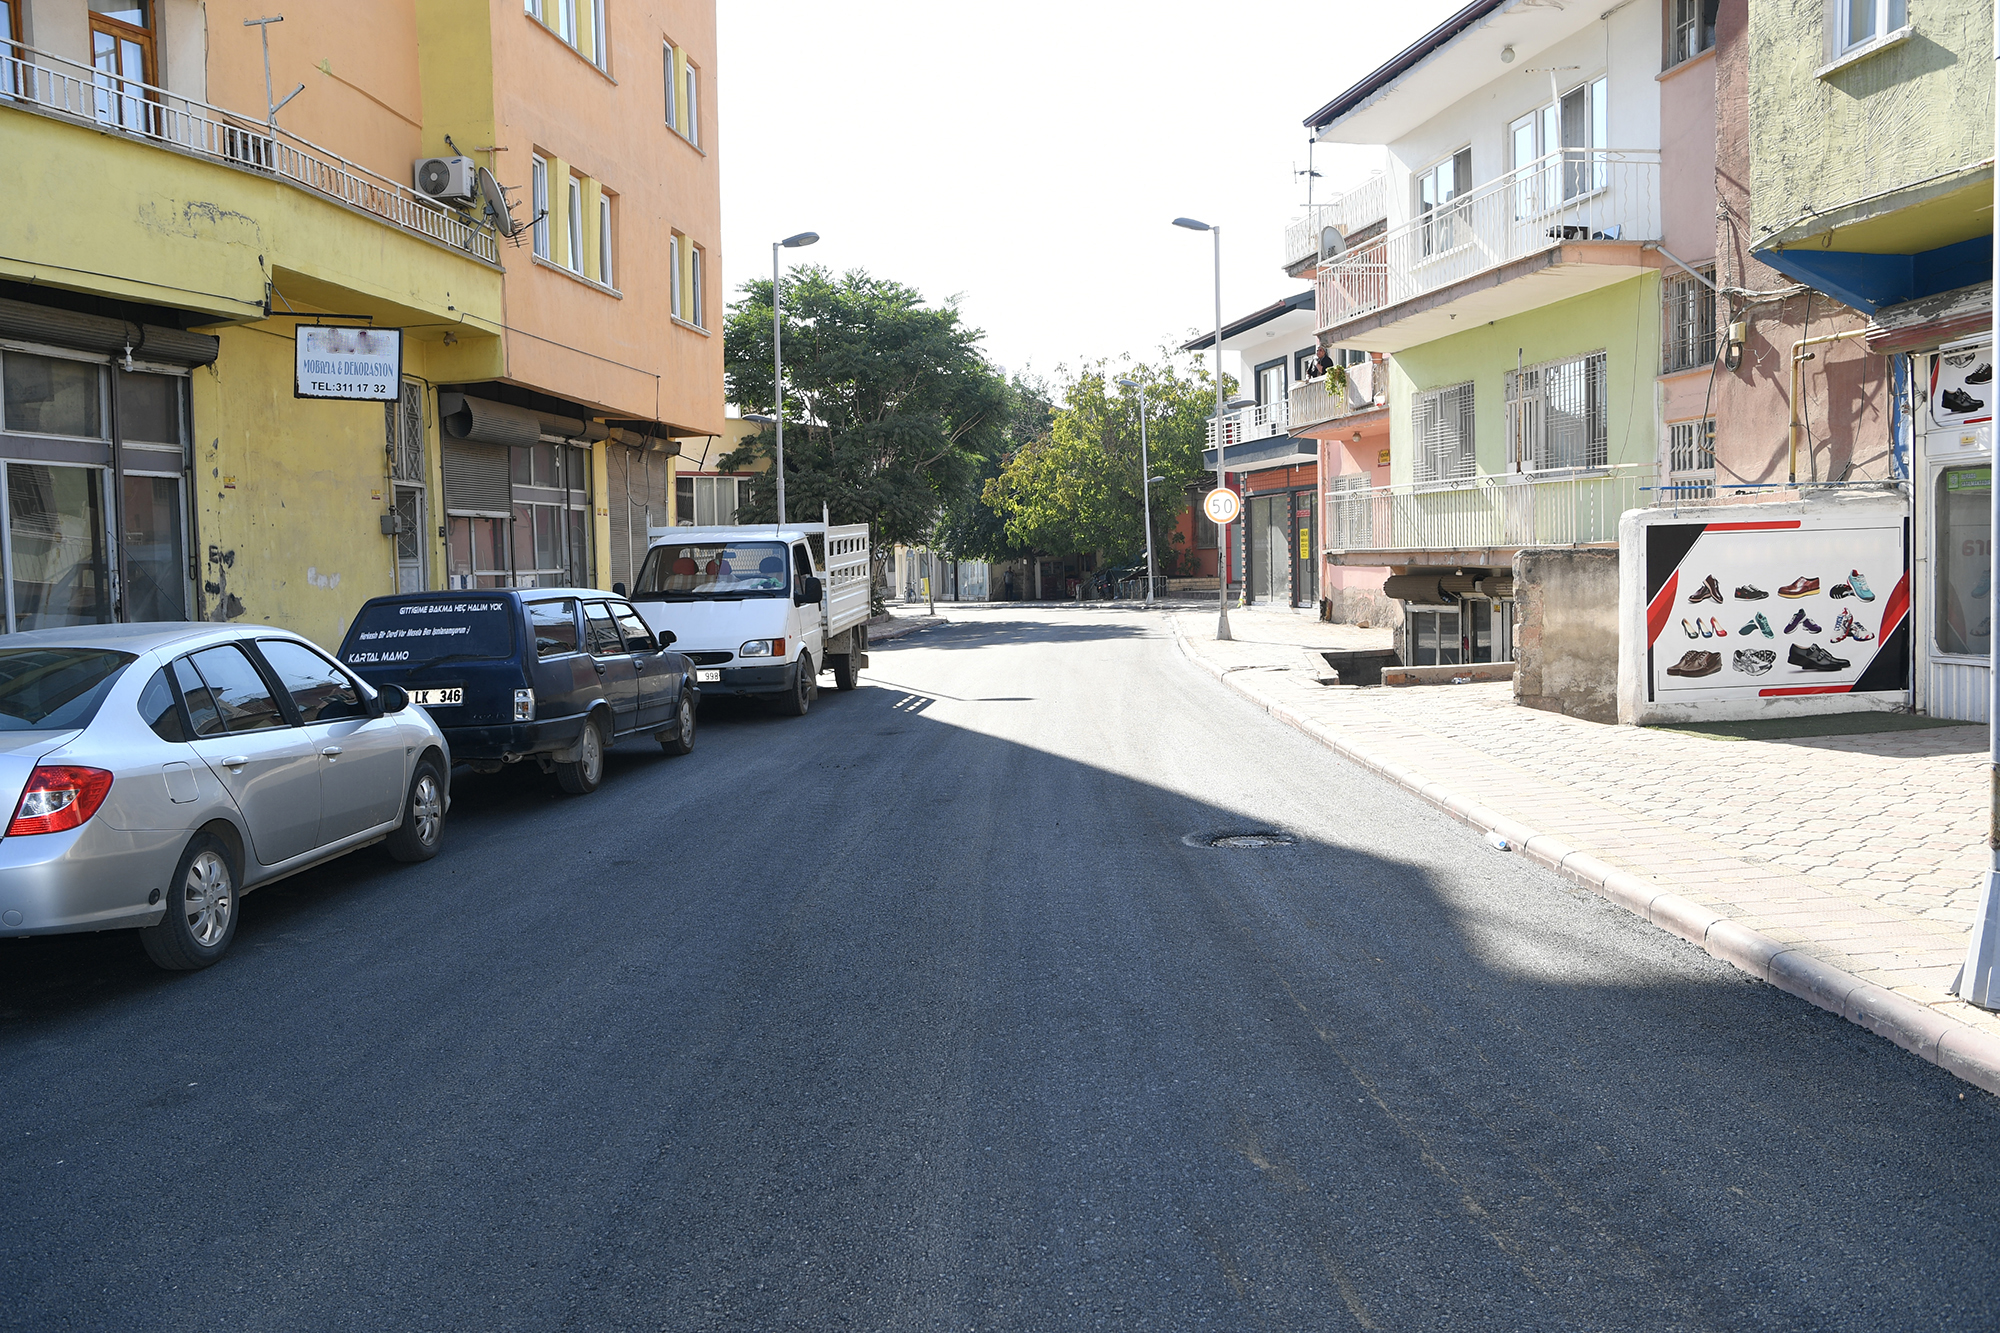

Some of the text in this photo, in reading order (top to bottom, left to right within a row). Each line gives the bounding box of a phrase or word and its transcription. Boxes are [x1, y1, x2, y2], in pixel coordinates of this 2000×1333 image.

[337, 361, 343, 375] &
[344, 361, 394, 377] DEKORASYON
[356, 384, 369, 393] 17
[373, 384, 386, 393] 32
[1213, 499, 1232, 514] 50
[428, 605, 453, 613] BAKMA
[489, 603, 503, 611] YOK
[348, 651, 409, 663] KARTAL MAMO
[705, 672, 718, 680] 998
[414, 689, 461, 704] LK 346
